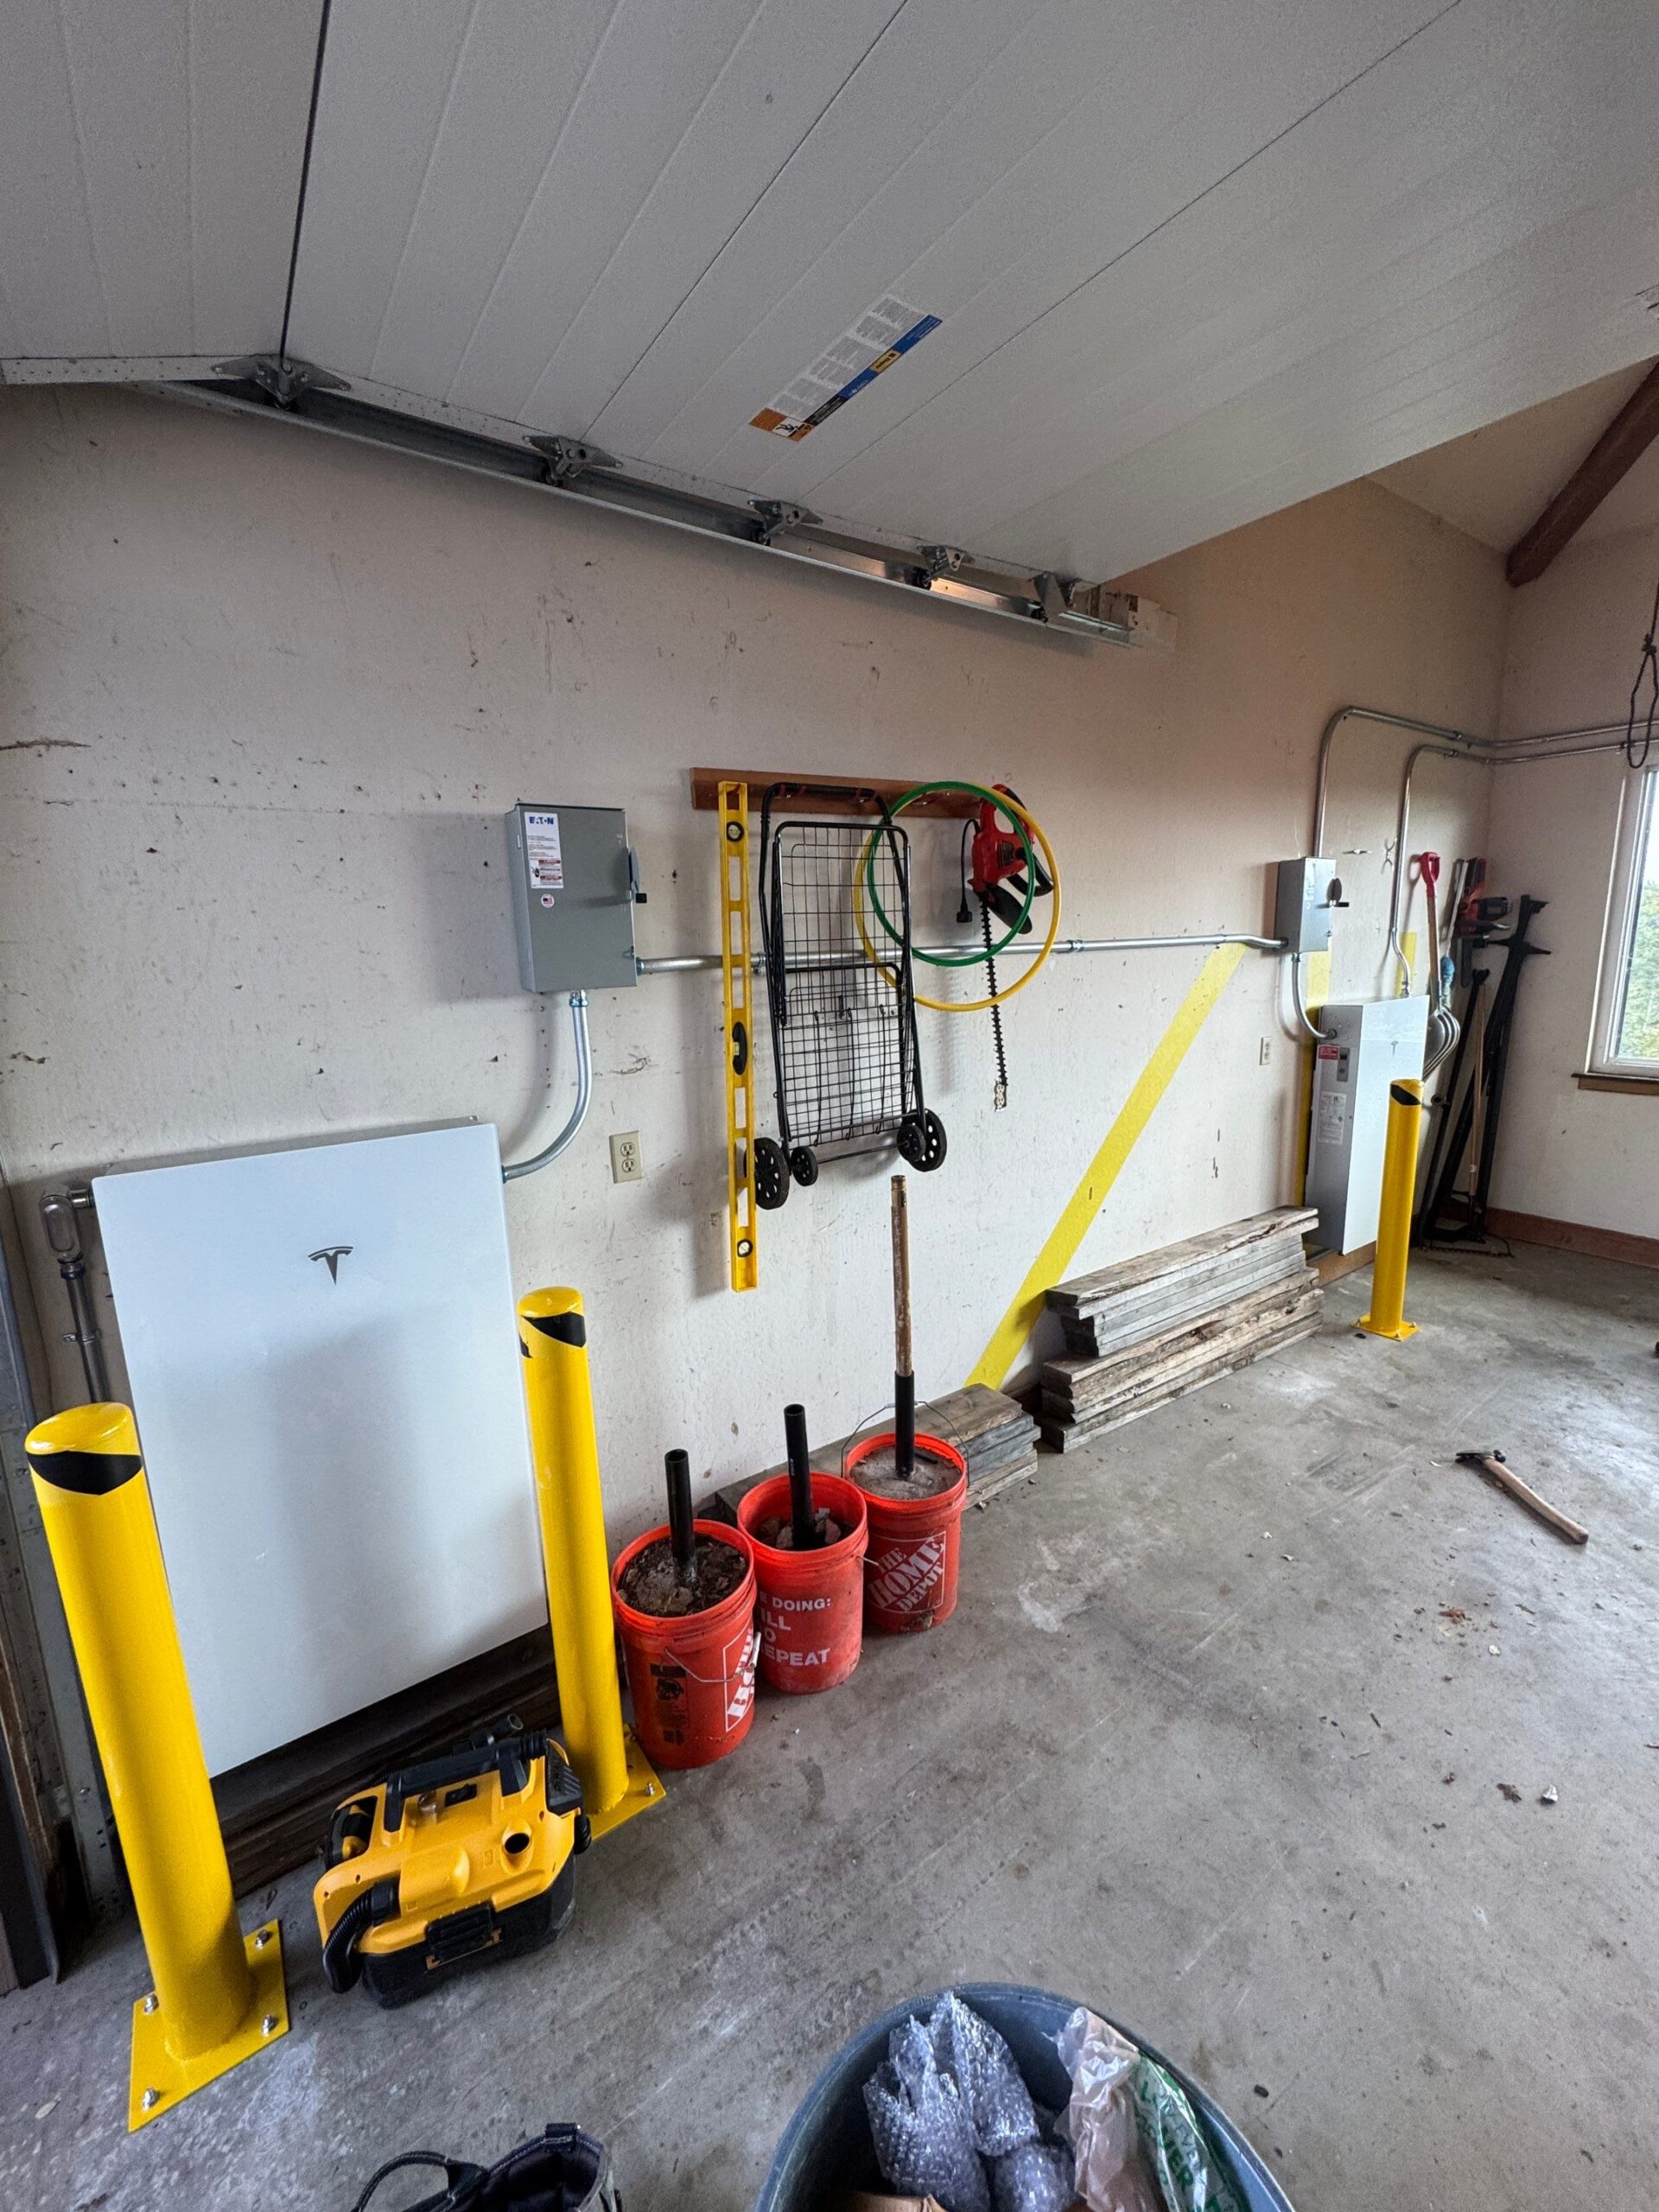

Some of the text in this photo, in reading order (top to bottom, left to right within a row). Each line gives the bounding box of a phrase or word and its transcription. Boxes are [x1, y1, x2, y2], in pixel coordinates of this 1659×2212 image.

[867, 1537, 945, 1608] HOME
[897, 1561, 944, 1612] DEPOT
[772, 1597, 831, 1611] DOING:
[760, 1608, 791, 1631] ILL
[763, 1626, 777, 1643] O
